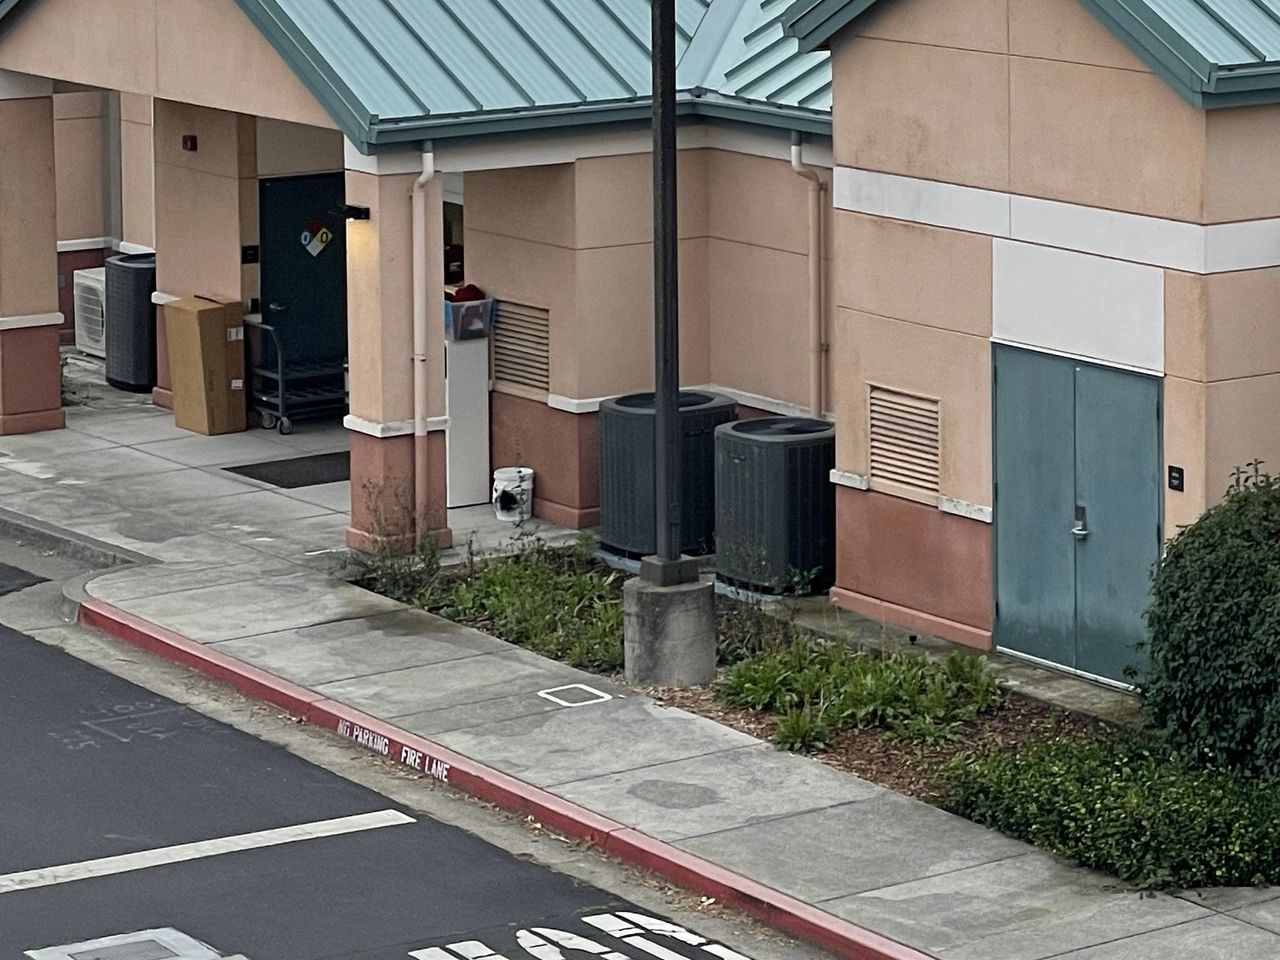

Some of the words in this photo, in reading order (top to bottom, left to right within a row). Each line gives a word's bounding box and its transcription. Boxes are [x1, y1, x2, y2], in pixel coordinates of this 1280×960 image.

[301, 231, 310, 245] 0
[320, 231, 329, 244] 0
[337, 719, 351, 737] NO
[352, 725, 389, 755] PARKING
[401, 746, 423, 769] FIRE
[424, 756, 450, 783] LANE
